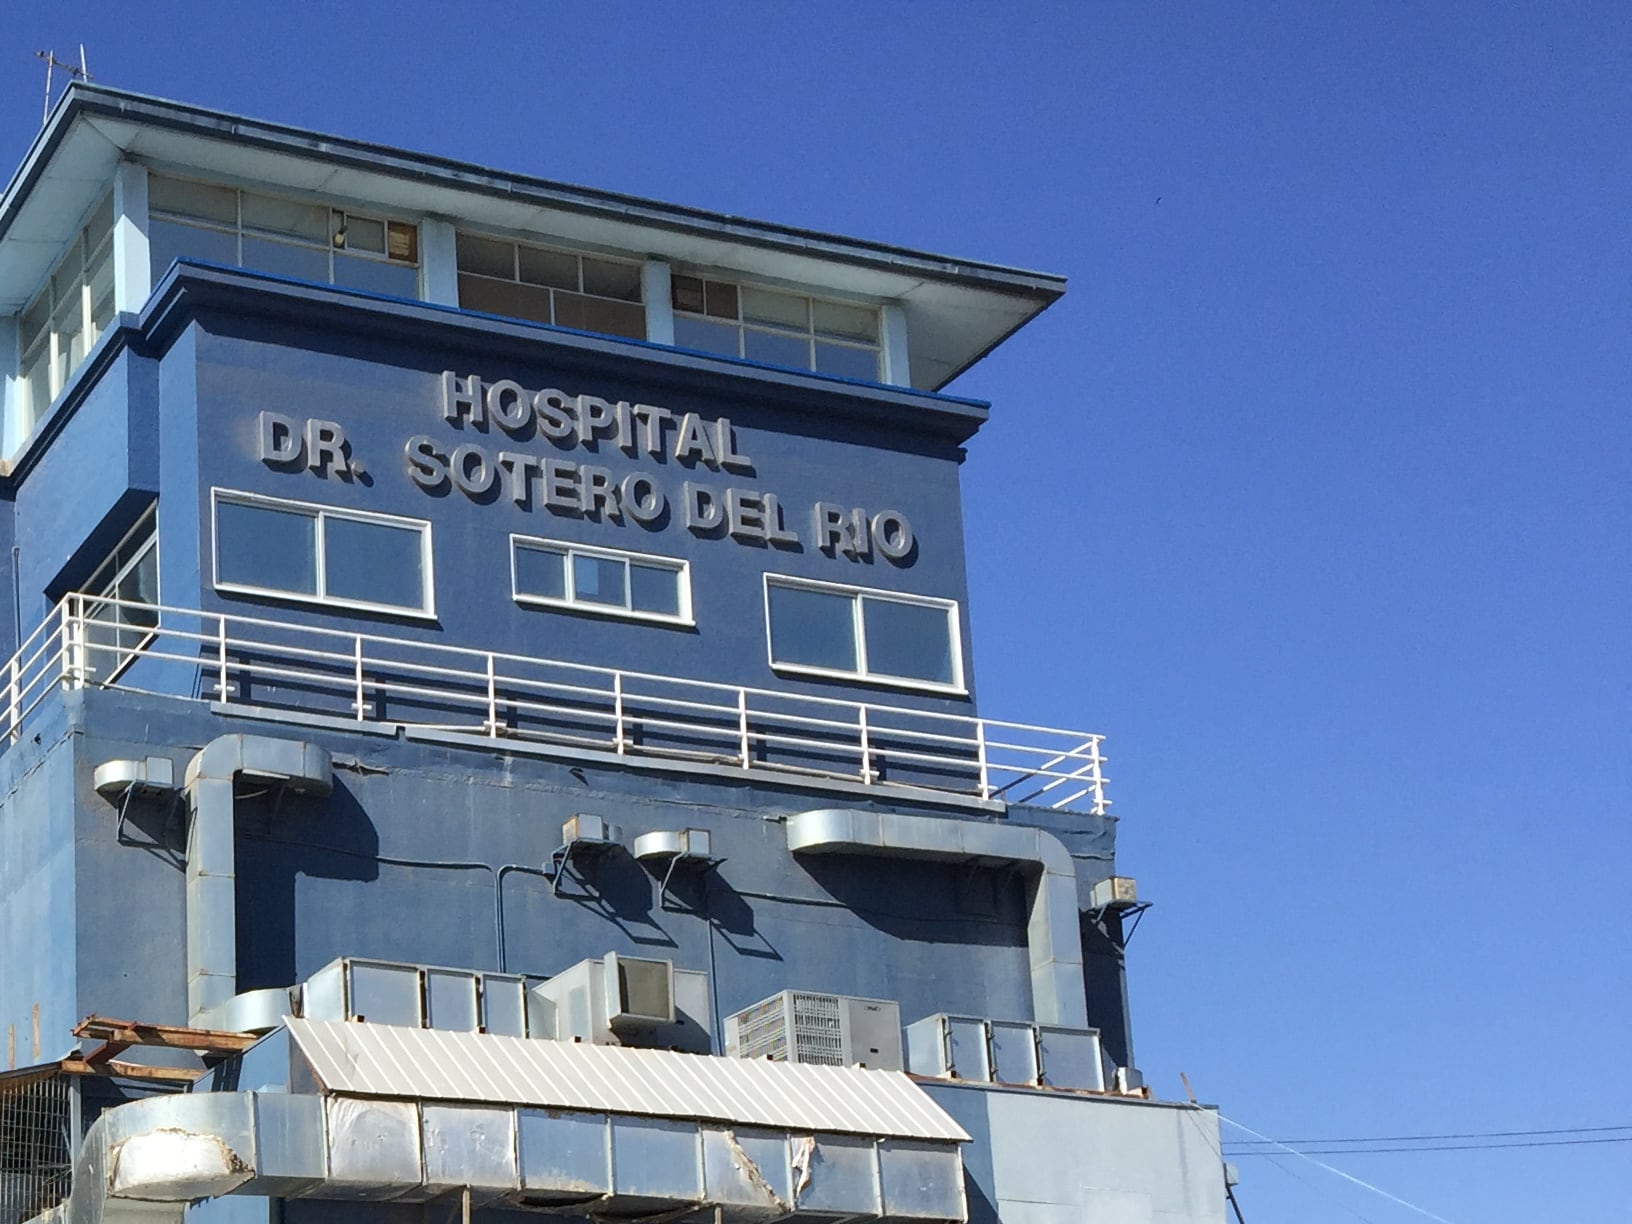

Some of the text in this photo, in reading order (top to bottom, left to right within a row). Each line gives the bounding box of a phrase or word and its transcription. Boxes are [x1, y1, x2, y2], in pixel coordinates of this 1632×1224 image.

[259, 410, 918, 563] DR. SOTERO DEL RIO
[442, 369, 756, 475] HOSPITAL
